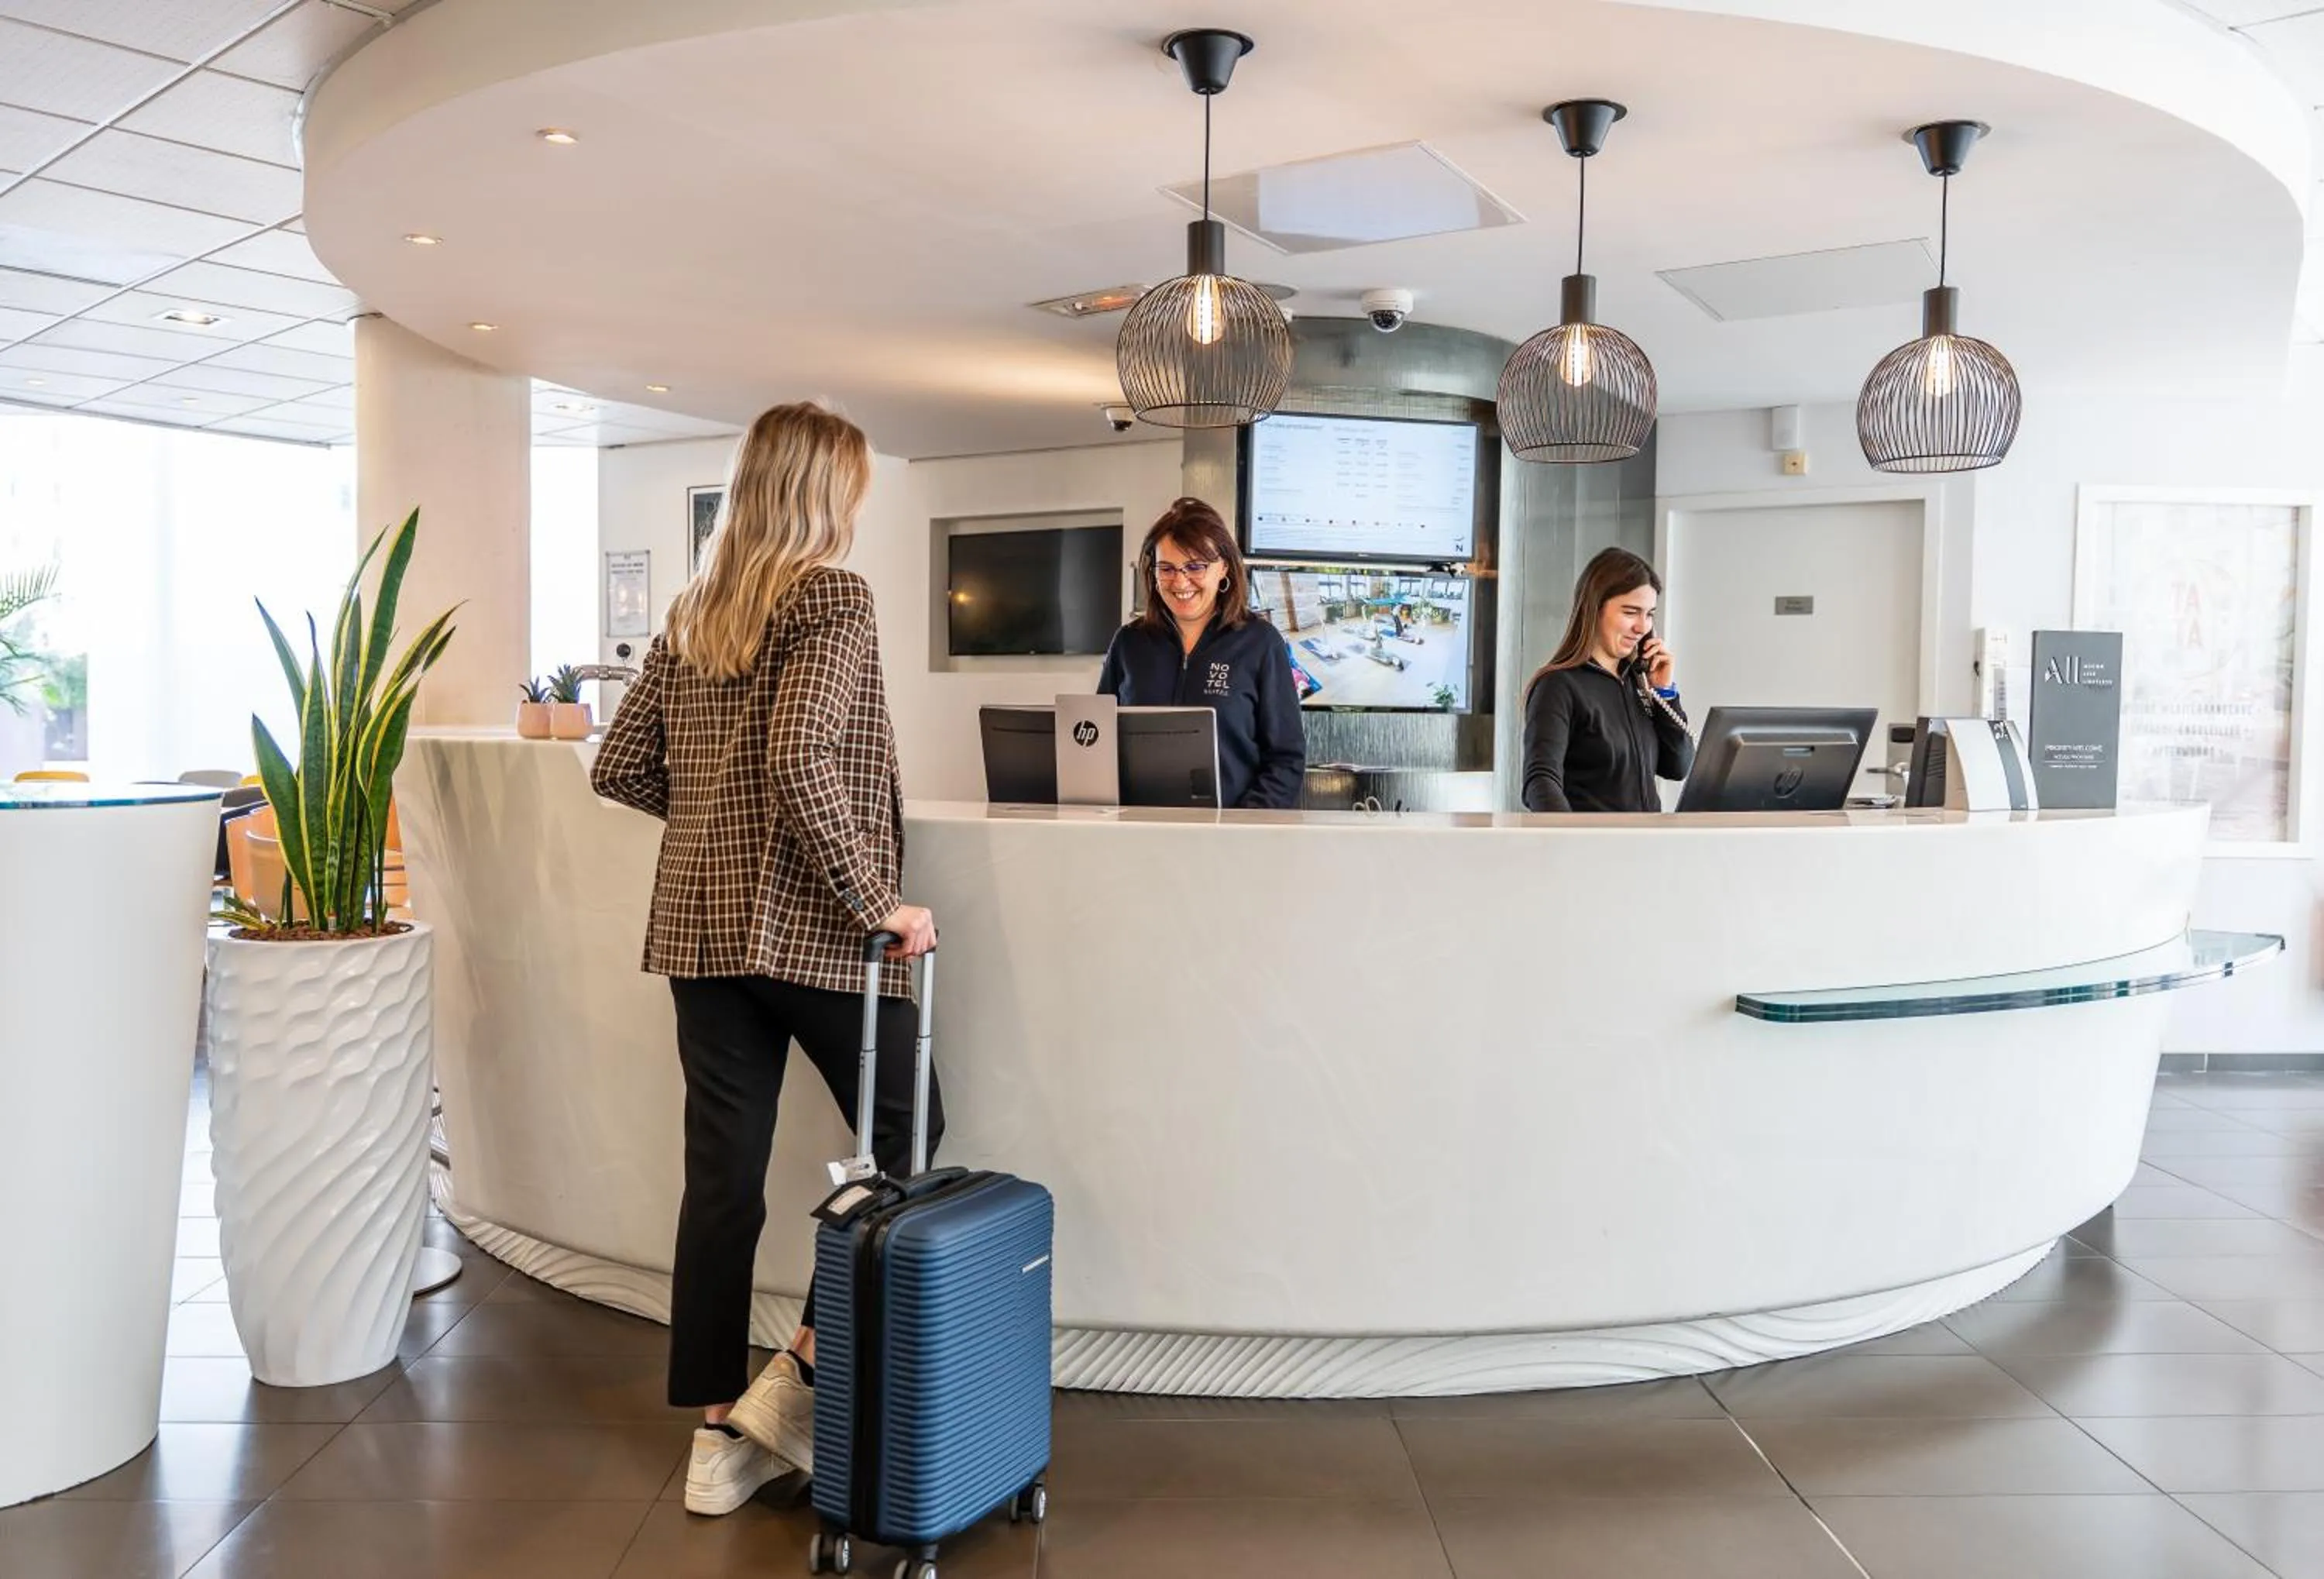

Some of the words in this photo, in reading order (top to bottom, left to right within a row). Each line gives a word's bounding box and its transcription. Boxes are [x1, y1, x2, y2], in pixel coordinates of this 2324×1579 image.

[1210, 662, 1229, 672] NO
[1208, 671, 1228, 679] VO
[1206, 679, 1231, 689] TEL
[1075, 721, 1097, 747] hp
